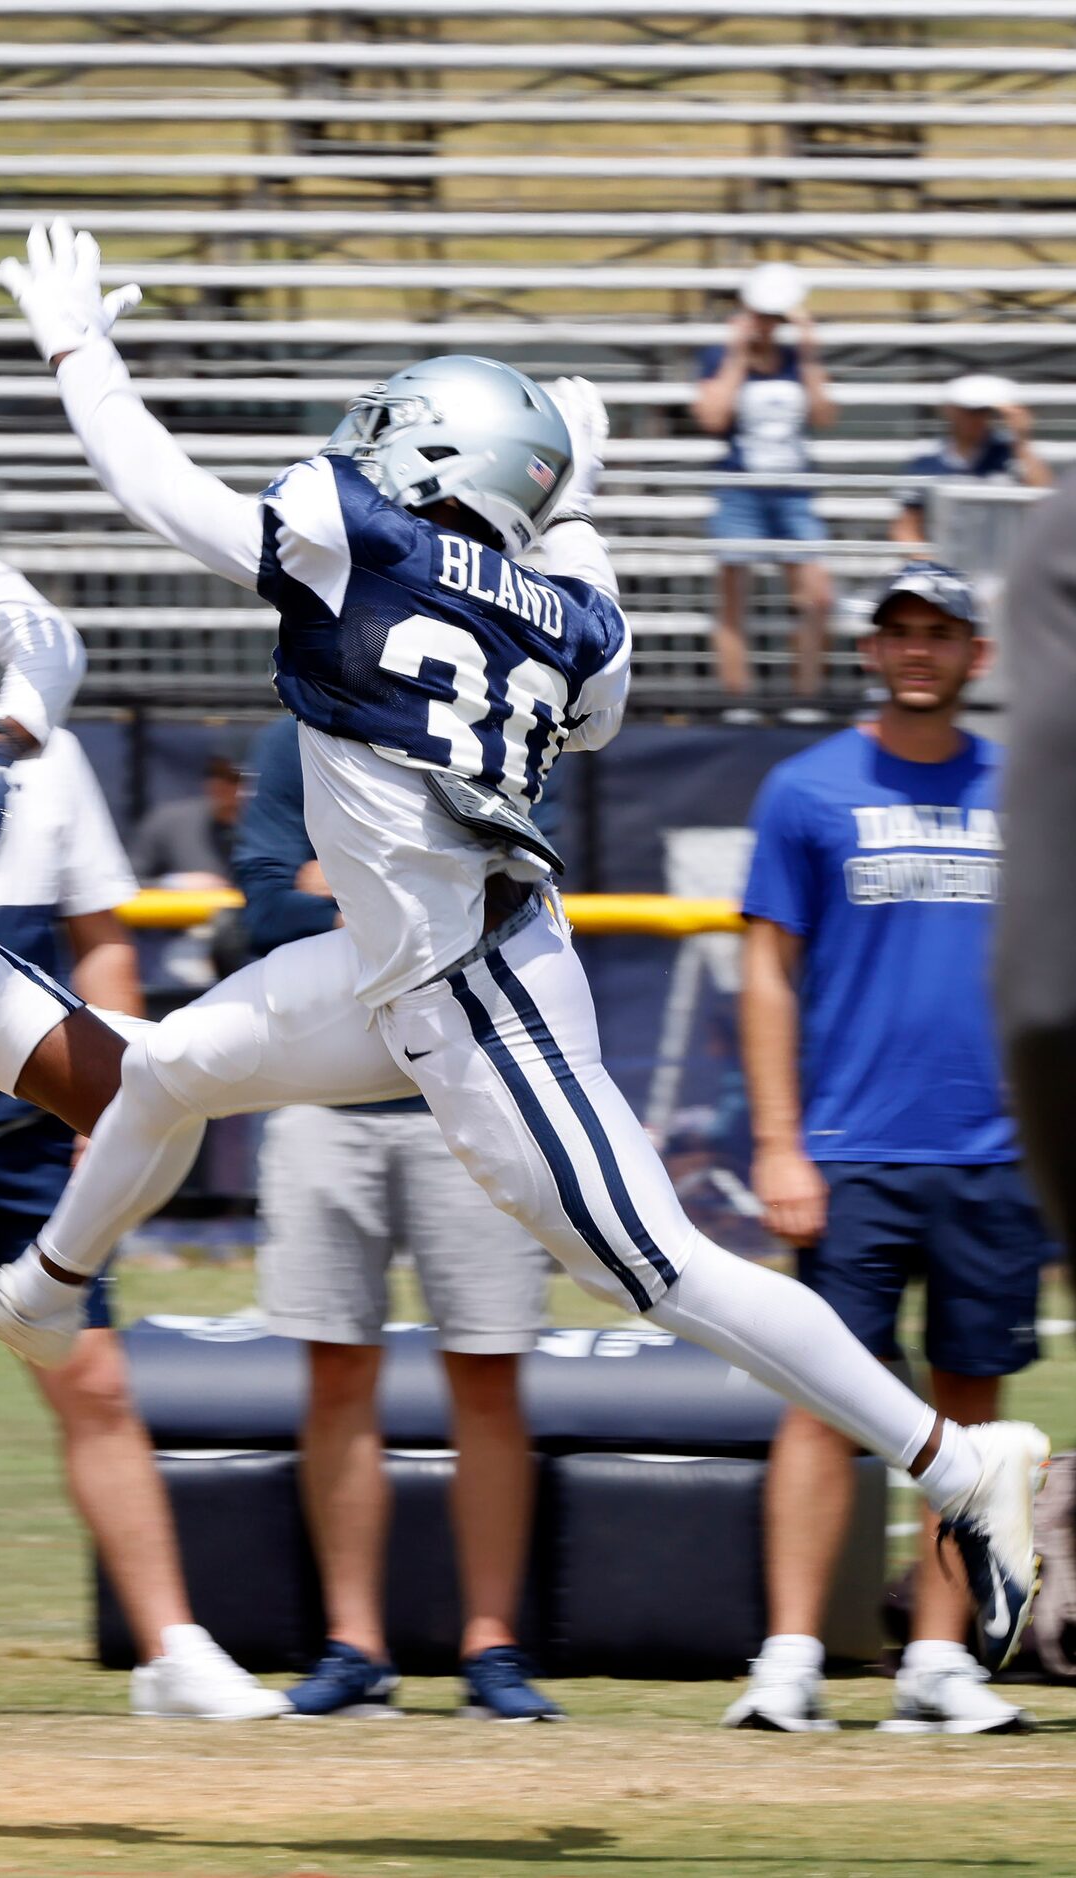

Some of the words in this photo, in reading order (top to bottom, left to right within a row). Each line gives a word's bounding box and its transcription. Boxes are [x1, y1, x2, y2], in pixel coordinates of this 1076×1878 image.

[437, 534, 565, 640] BLAND
[371, 613, 571, 805] 30
[850, 804, 1006, 850] DALLA
